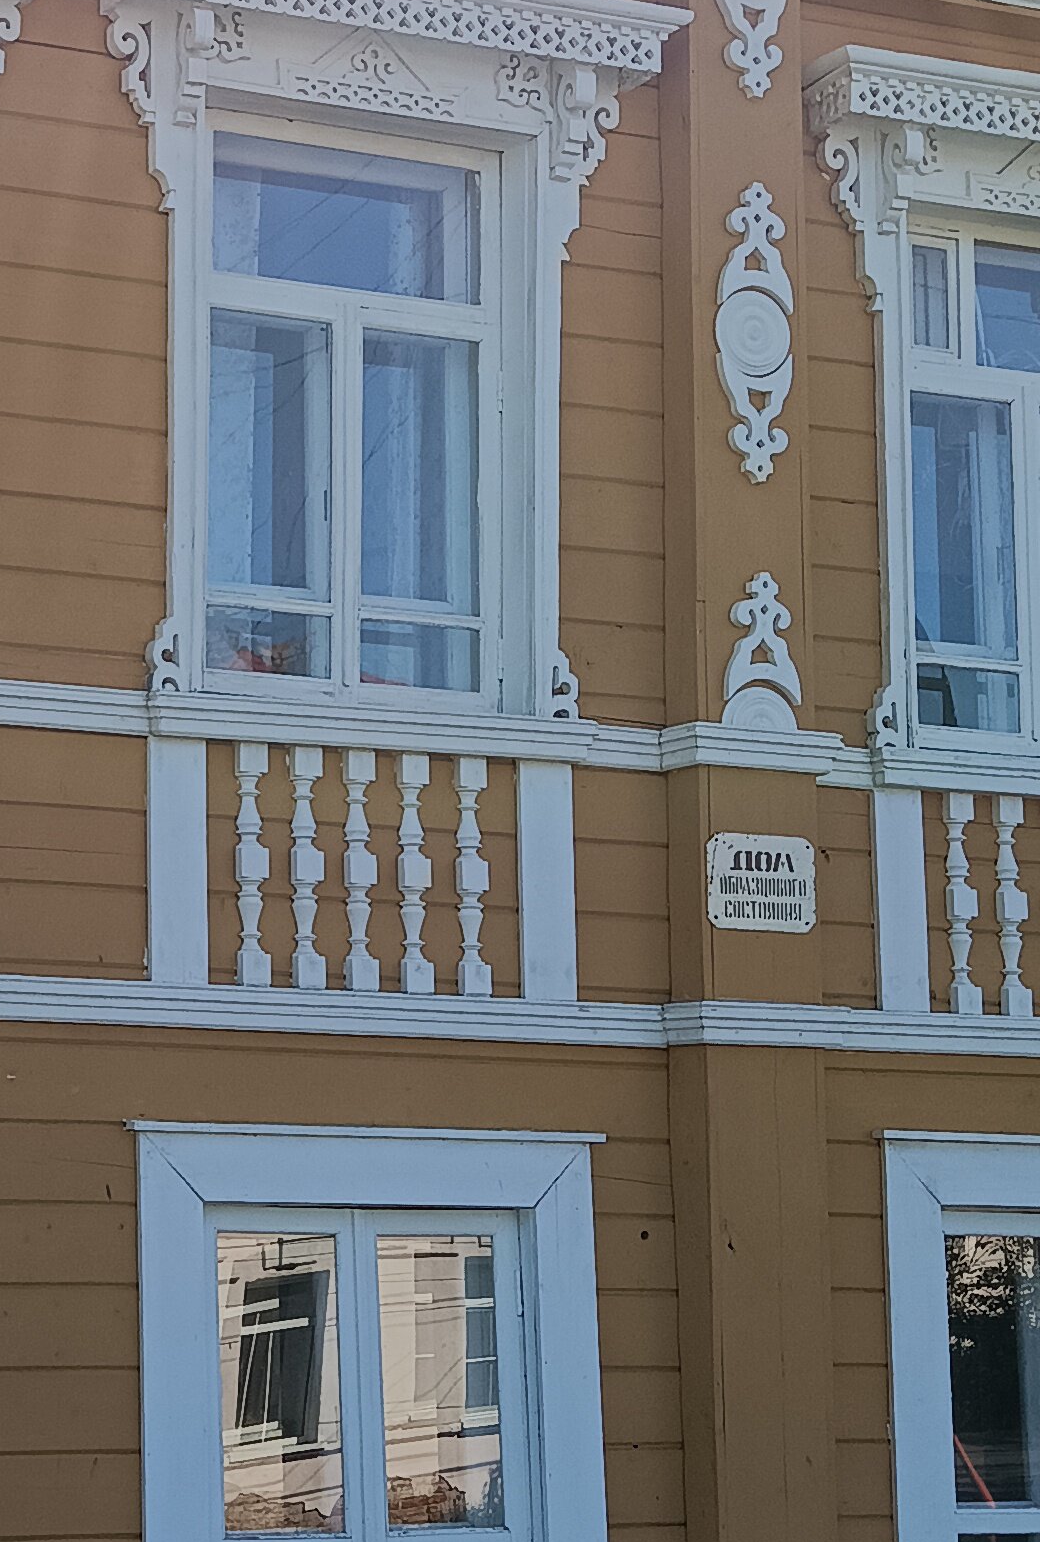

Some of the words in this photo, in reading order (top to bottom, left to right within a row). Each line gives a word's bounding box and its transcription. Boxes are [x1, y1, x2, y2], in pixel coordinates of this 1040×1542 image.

[729, 850, 795, 873] ДОМ
[719, 875, 807, 898] ОБРАЗЦОВОГО
[724, 900, 802, 922] СОСТОЯНИЯ
